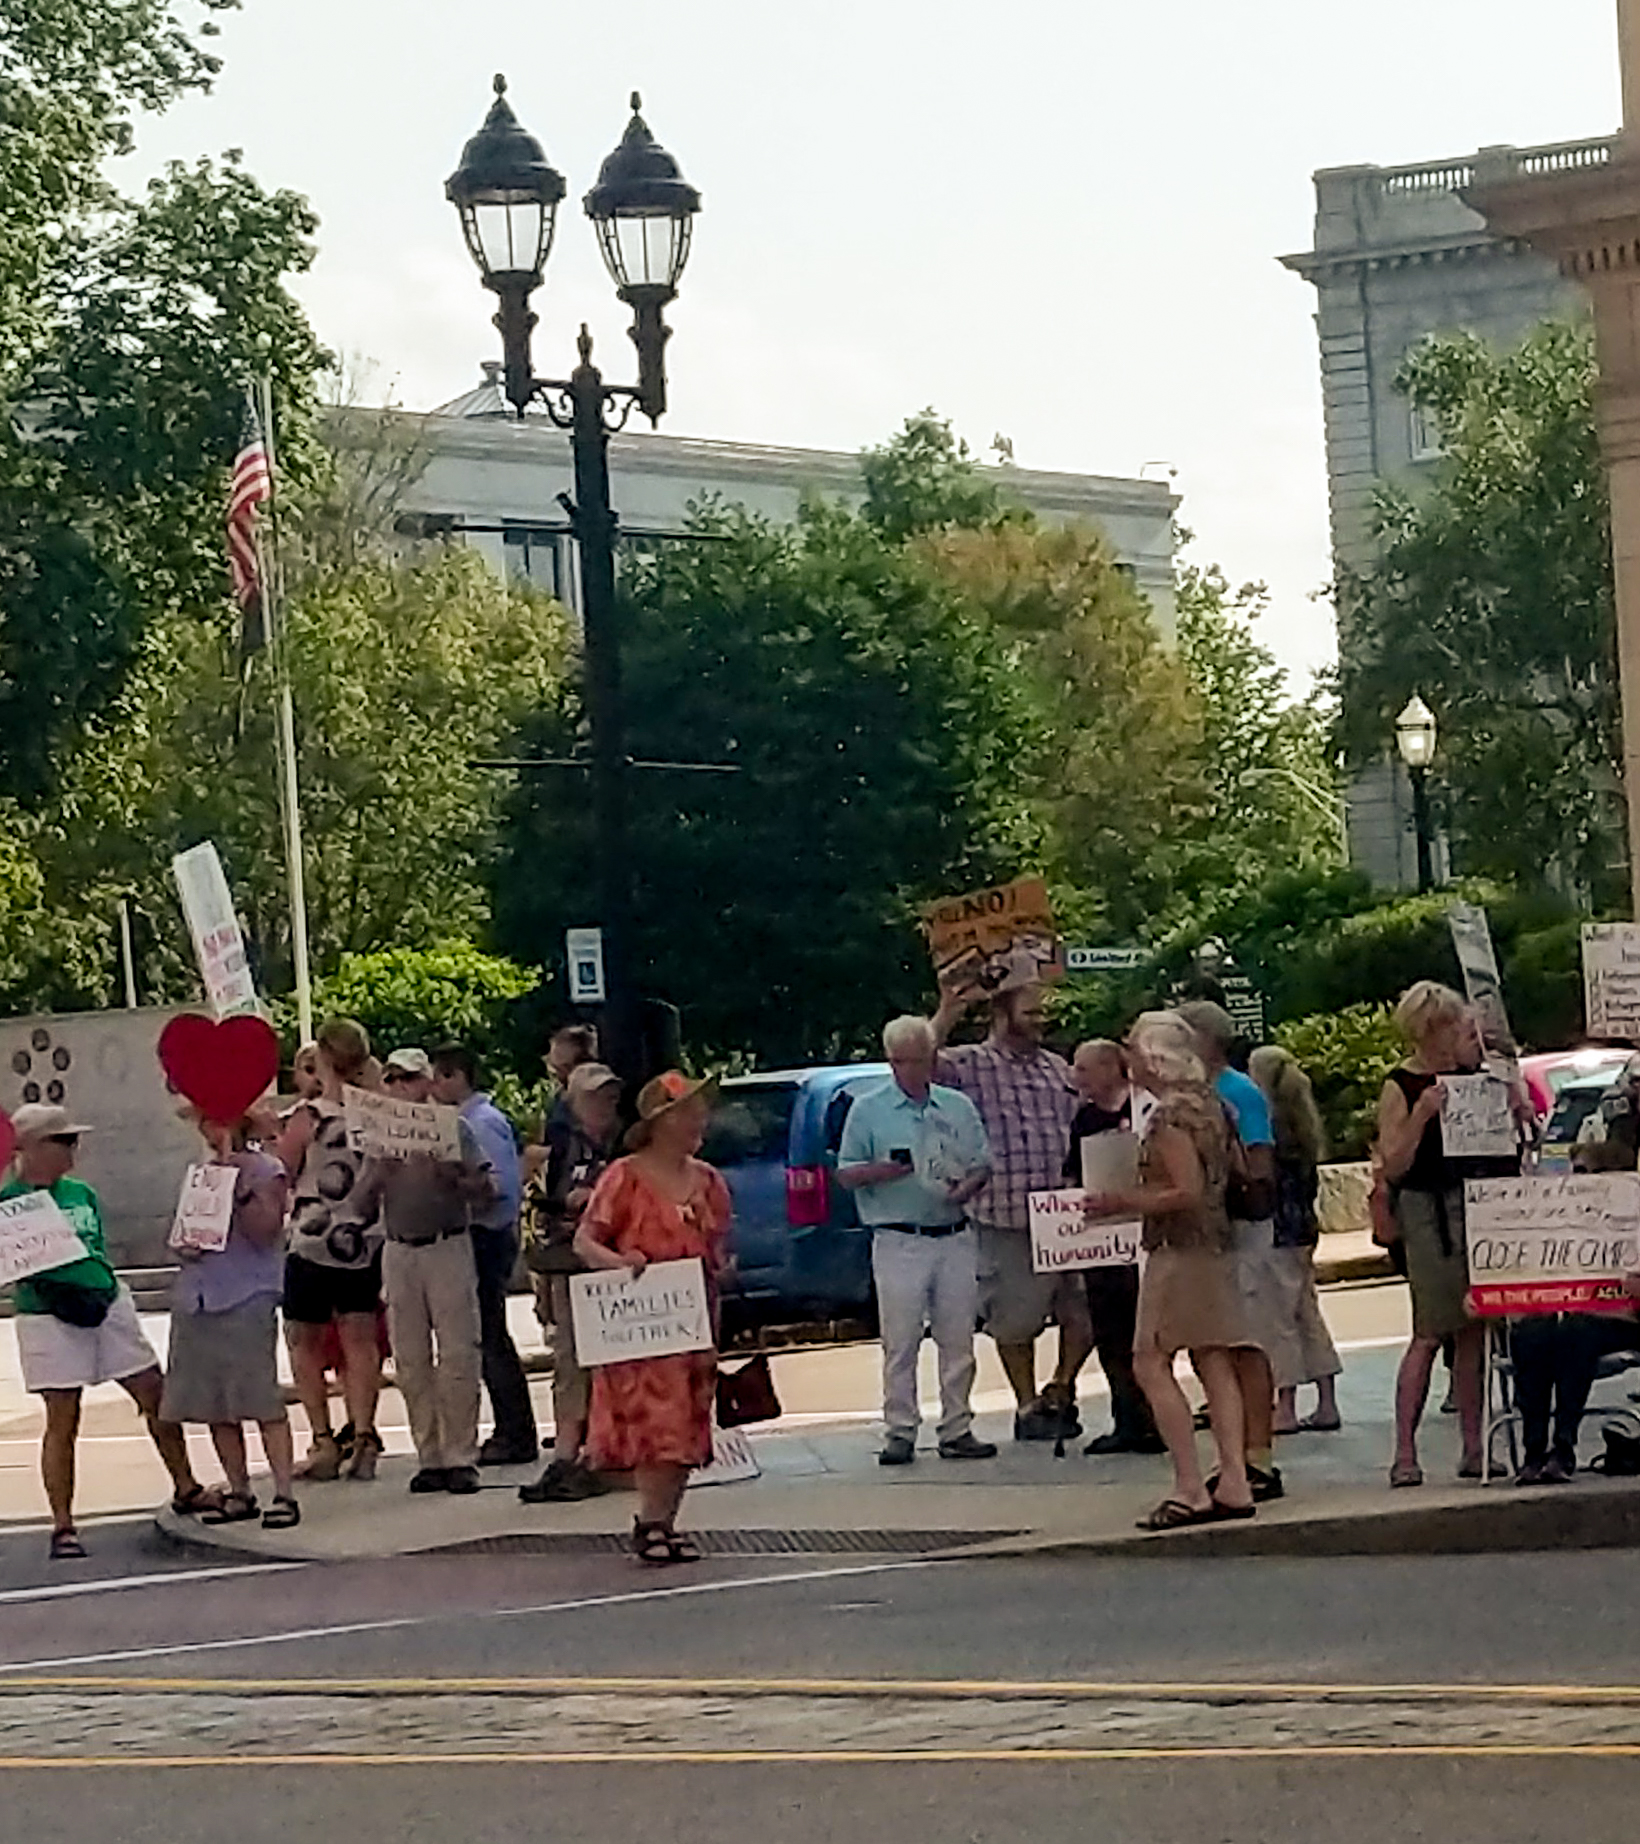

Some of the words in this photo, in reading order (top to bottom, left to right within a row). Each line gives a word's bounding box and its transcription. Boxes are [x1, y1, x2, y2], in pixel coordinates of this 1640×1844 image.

[1036, 1232, 1138, 1268] humanity
[1540, 1238, 1576, 1267] THE
[599, 1290, 696, 1323] FAMILIES
